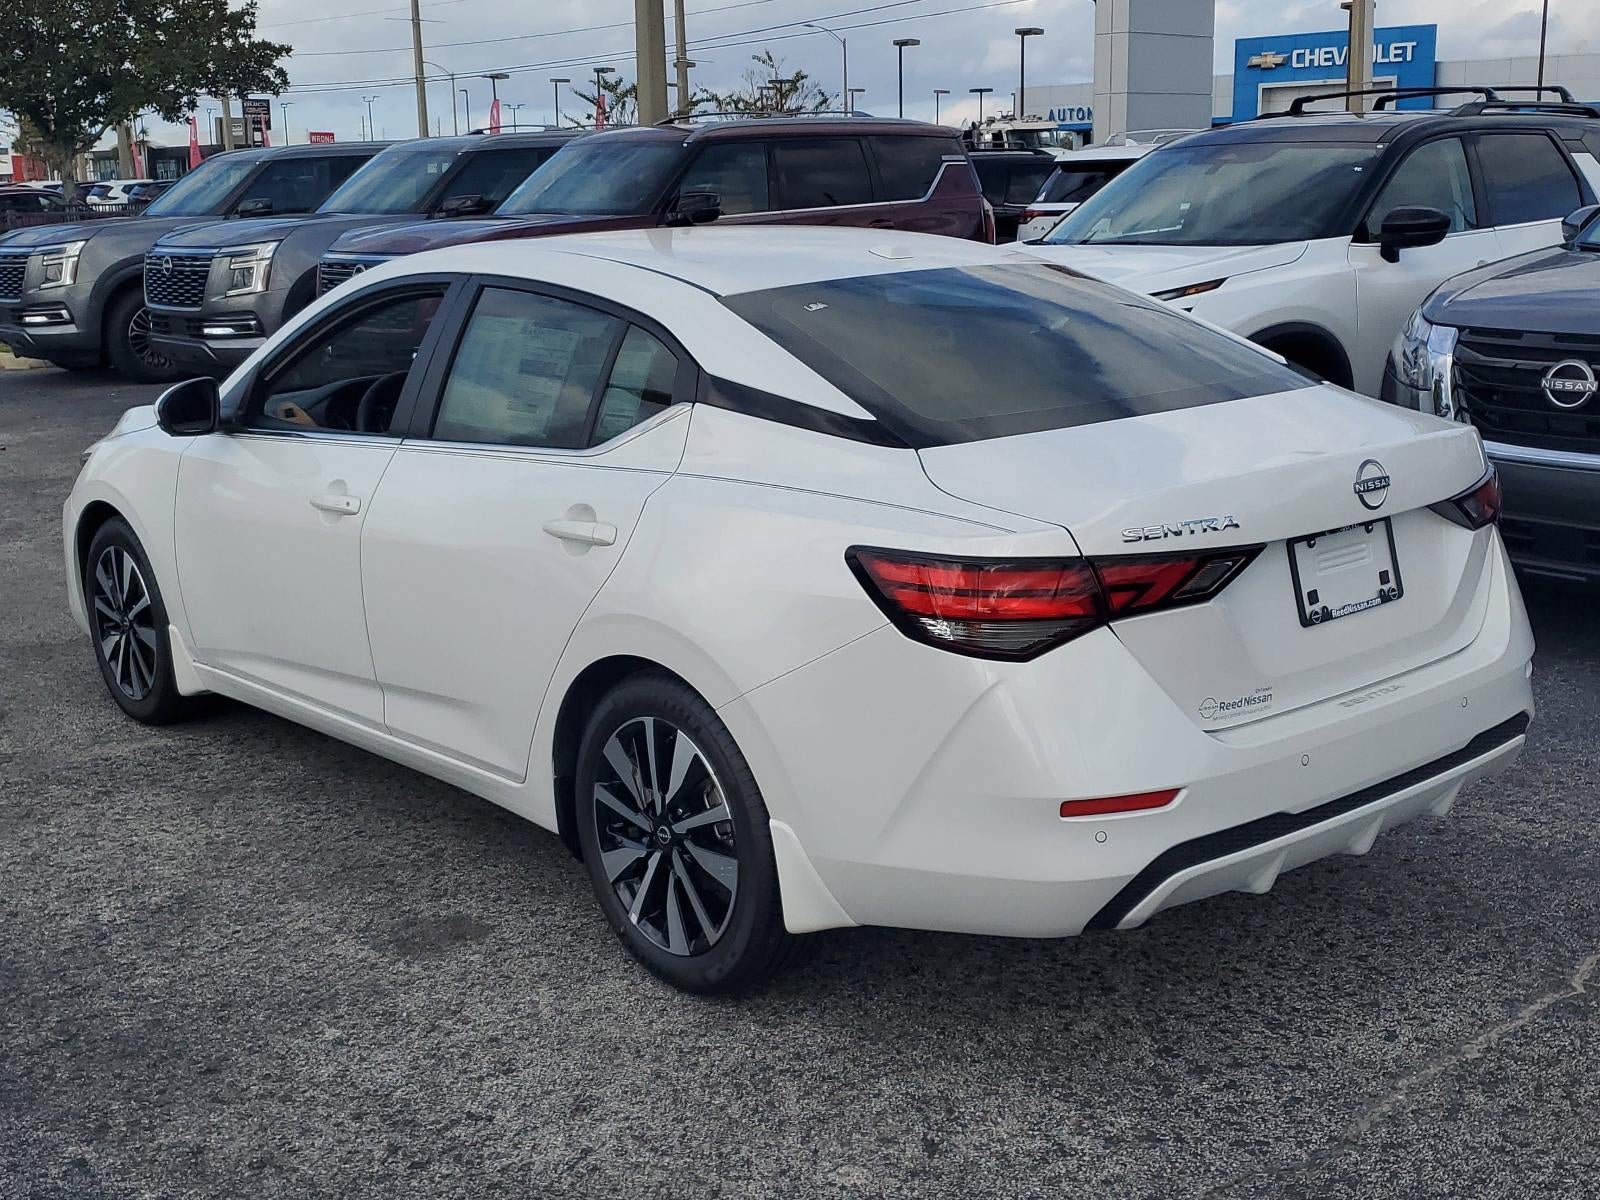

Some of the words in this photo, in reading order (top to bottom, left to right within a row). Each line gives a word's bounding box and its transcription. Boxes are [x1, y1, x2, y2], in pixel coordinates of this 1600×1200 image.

[1291, 41, 1418, 68] CHEVLET
[311, 135, 334, 144] WRONG
[1541, 379, 1597, 391] NISSAN
[1355, 477, 1390, 492] NISSAN
[1121, 515, 1240, 543] SENTRA
[1331, 598, 1382, 618] ReedNissan.com
